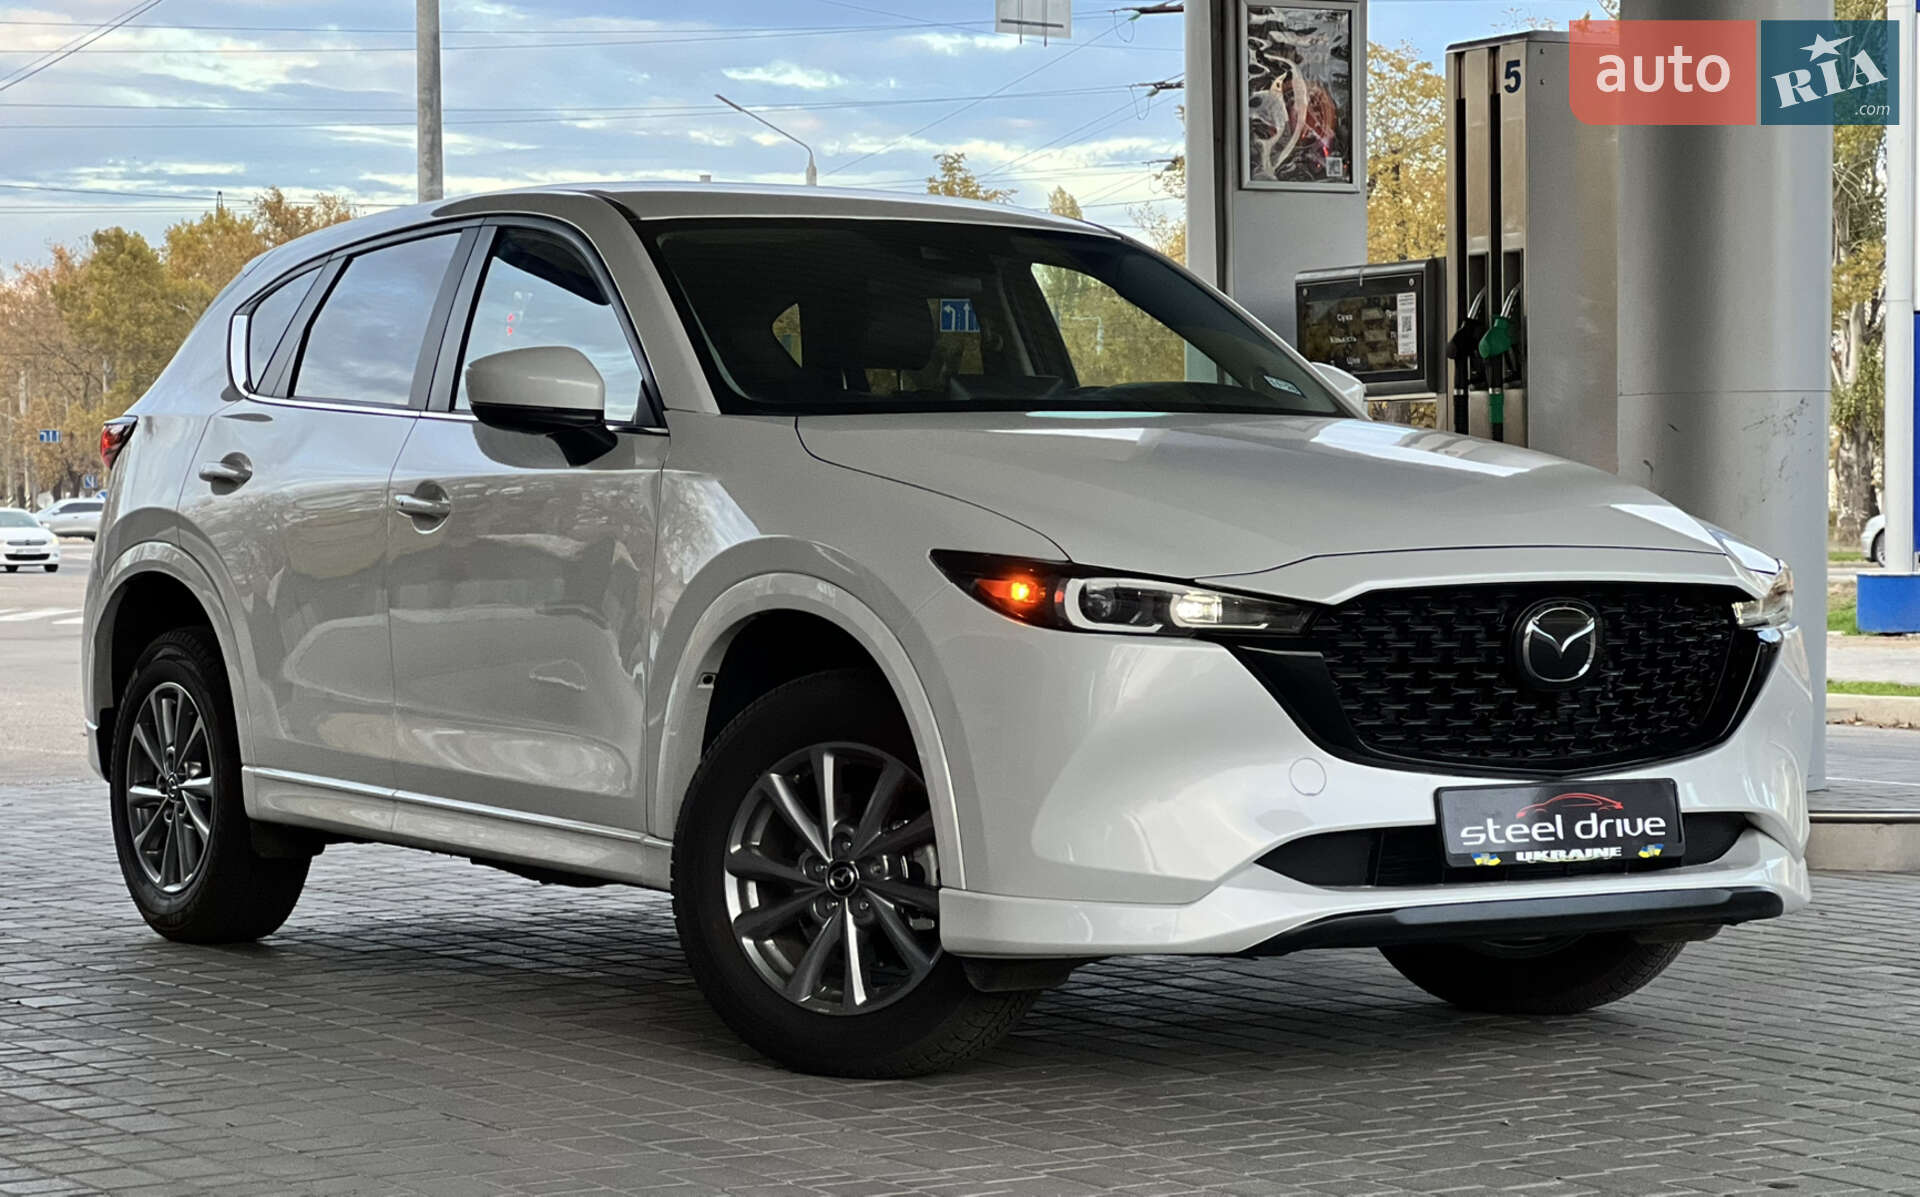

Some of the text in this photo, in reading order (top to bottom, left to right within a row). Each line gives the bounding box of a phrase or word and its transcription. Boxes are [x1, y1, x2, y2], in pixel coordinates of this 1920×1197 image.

[1504, 59, 1522, 94] 5
[1460, 812, 1666, 846] steel drive
[1515, 846, 1622, 863] UKRAINE
